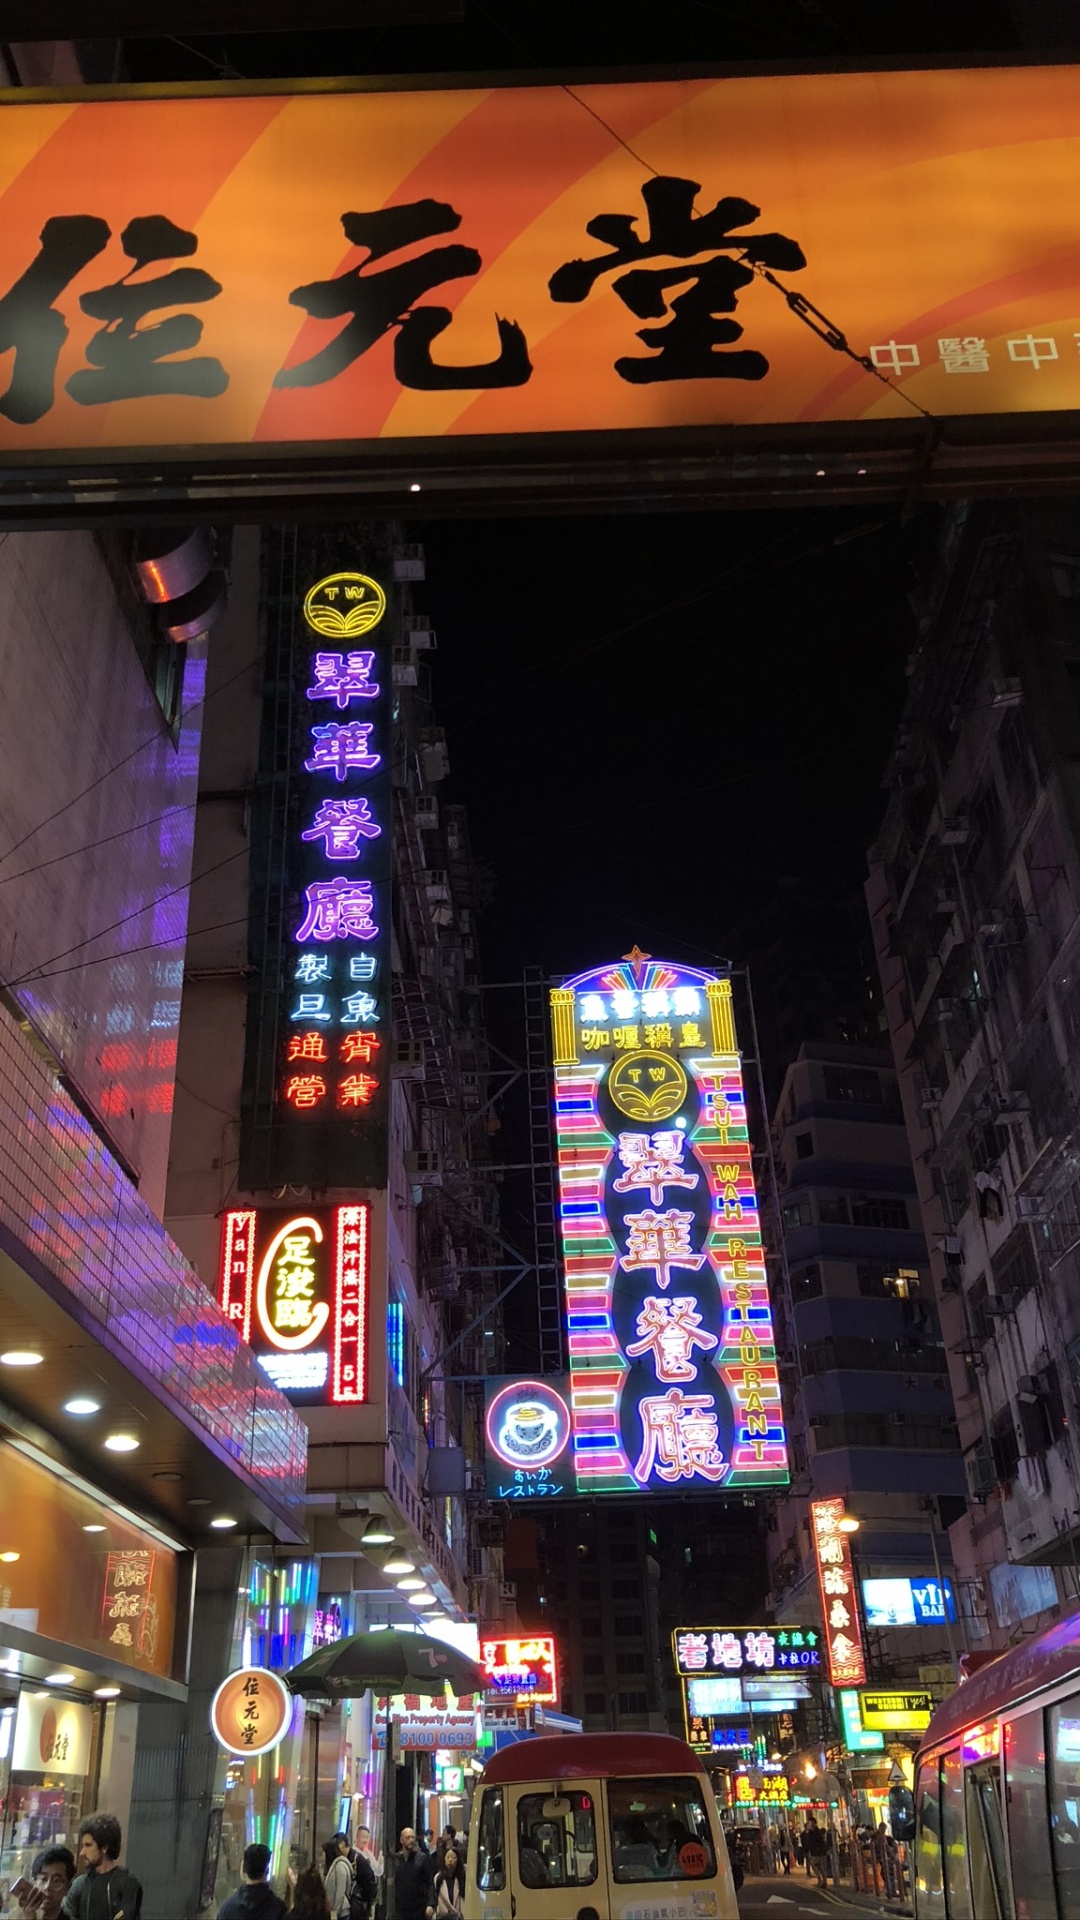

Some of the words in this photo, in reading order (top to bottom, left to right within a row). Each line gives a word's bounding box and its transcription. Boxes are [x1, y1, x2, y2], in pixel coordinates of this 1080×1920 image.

[0, 176, 806, 424] 位元堂
[869, 333, 1080, 376] 中醫中
[296, 651, 382, 942] 翠華餐廳
[710, 1074, 732, 1146] TSUI
[717, 1165, 743, 1220] WAH
[612, 1130, 730, 1482] 翠華餐廳
[728, 1238, 767, 1460] RESTAURANT
[499, 1484, 564, 1498] レストラン
[240, 1676, 261, 1746] 位元堂
[410, 1714, 444, 1726] Property
[445, 1714, 475, 1726] Agency
[438, 1731, 473, 1746] 0693
